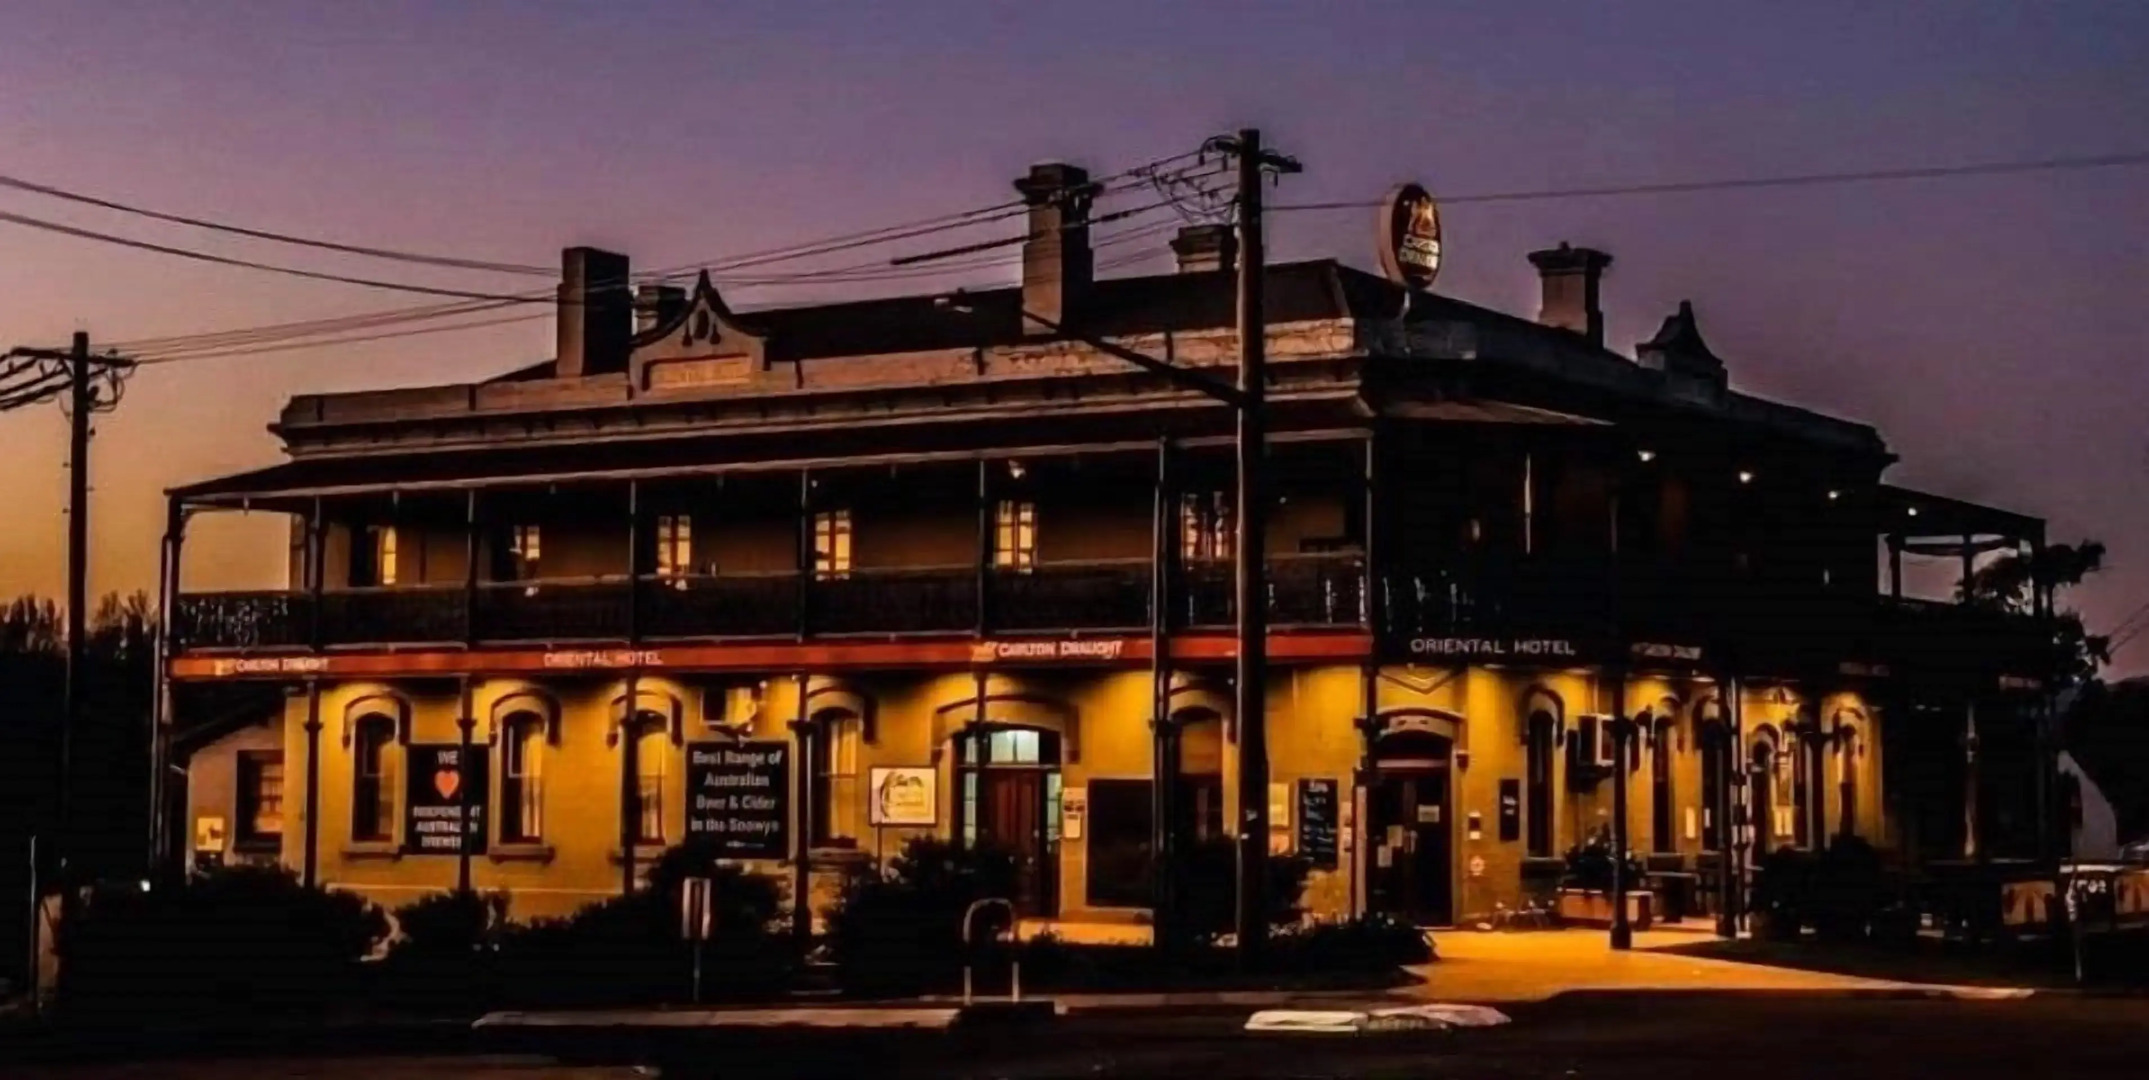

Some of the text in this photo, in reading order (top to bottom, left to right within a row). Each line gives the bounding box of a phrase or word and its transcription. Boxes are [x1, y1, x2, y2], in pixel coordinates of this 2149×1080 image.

[1410, 638, 1576, 657] ORIENTAL HOTEL
[543, 651, 663, 668] ORIENTAL HOTEL
[437, 750, 459, 766] WE
[693, 749, 783, 768] Best Range of
[703, 771, 770, 788] Australian
[728, 794, 739, 811] &
